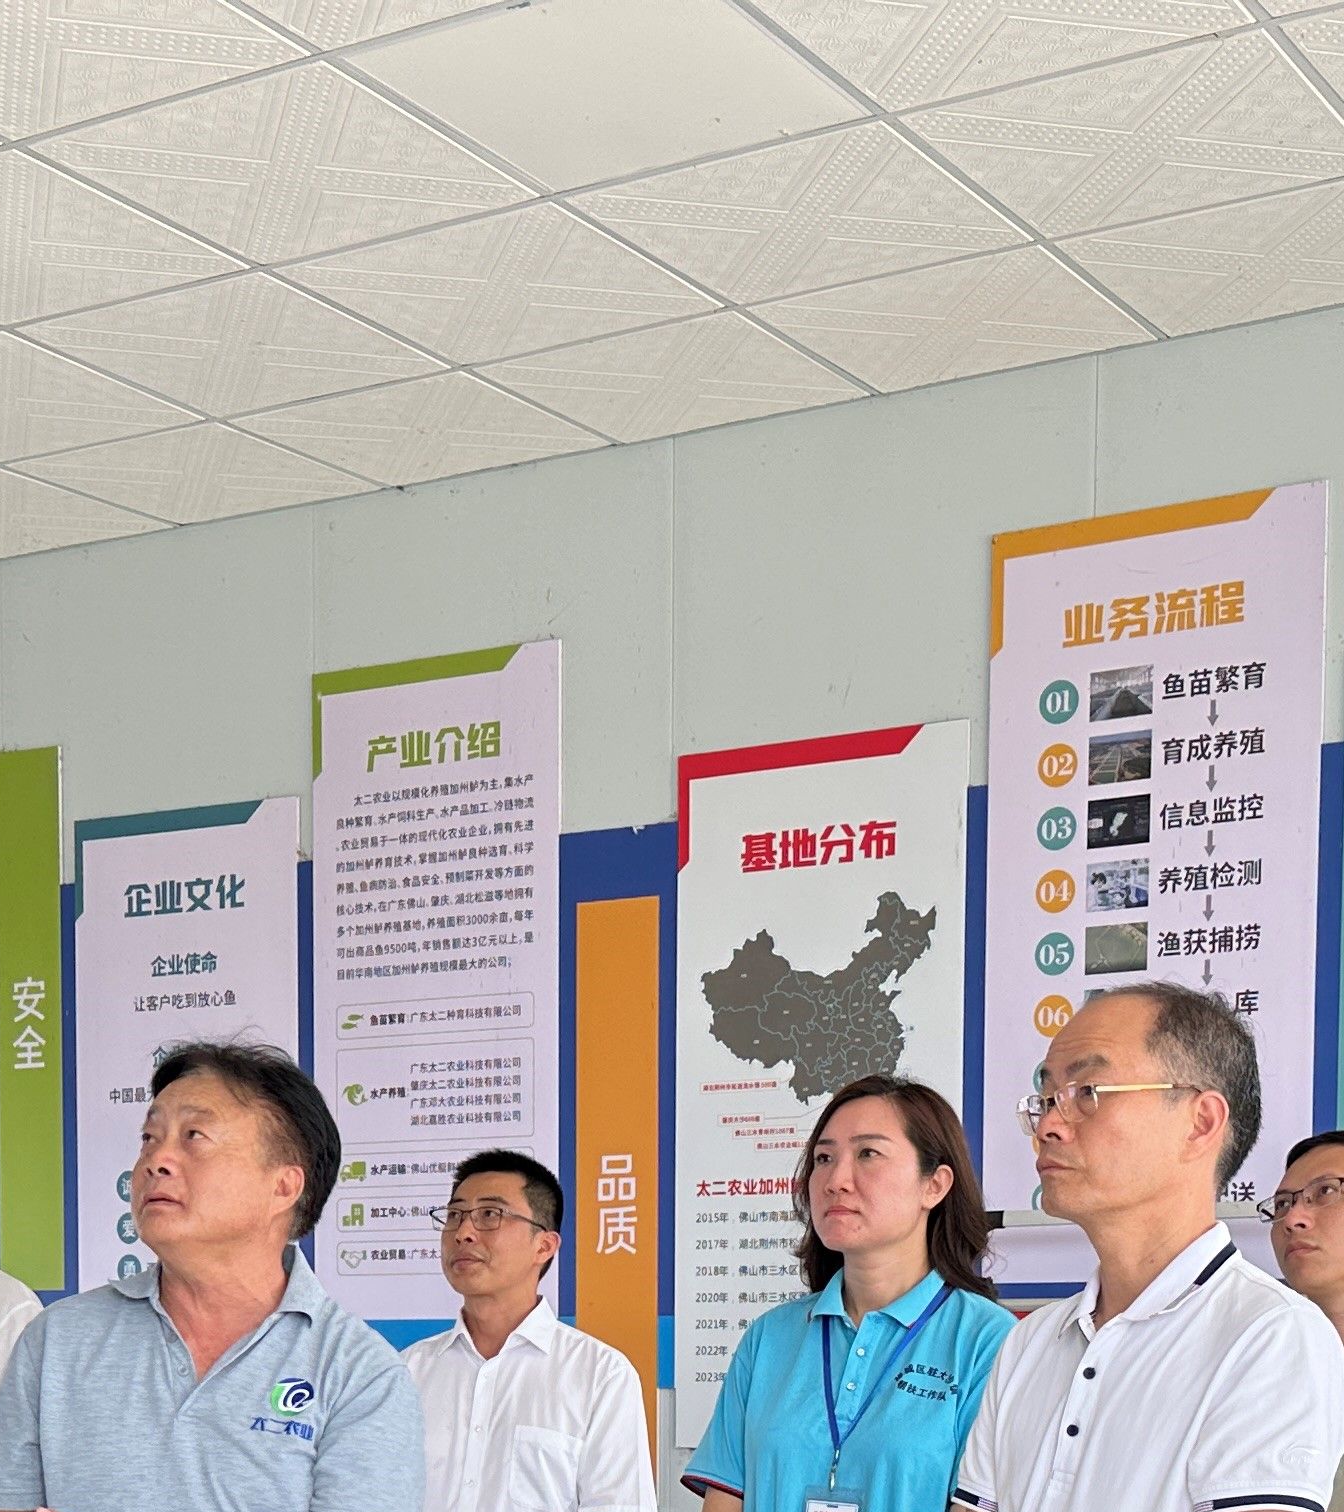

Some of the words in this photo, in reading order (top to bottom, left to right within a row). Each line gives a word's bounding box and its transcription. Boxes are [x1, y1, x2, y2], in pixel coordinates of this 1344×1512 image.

[1062, 580, 1246, 649] 业务流程
[1161, 661, 1267, 700] 鱼苗繁育
[1045, 690, 1071, 714] 01
[366, 720, 501, 773] 产业介绍
[1161, 727, 1266, 765] 育成养殖
[1042, 756, 1074, 778] 02
[1041, 818, 1073, 840] 03
[1159, 793, 1264, 831] 信息监控
[740, 820, 898, 873] 基地分布
[1039, 881, 1073, 904] 04
[1158, 858, 1263, 895] 养殖检测
[123, 874, 246, 919] 企业文化
[1039, 943, 1072, 965] 05
[1156, 923, 1261, 957] 渔获捕捞
[150, 951, 218, 978] 企业使命
[133, 989, 237, 1012] 让客户吃到放心鱼
[1037, 1006, 1071, 1029] 06
[12, 976, 47, 1070] 安全
[596, 1153, 638, 1255] 品质
